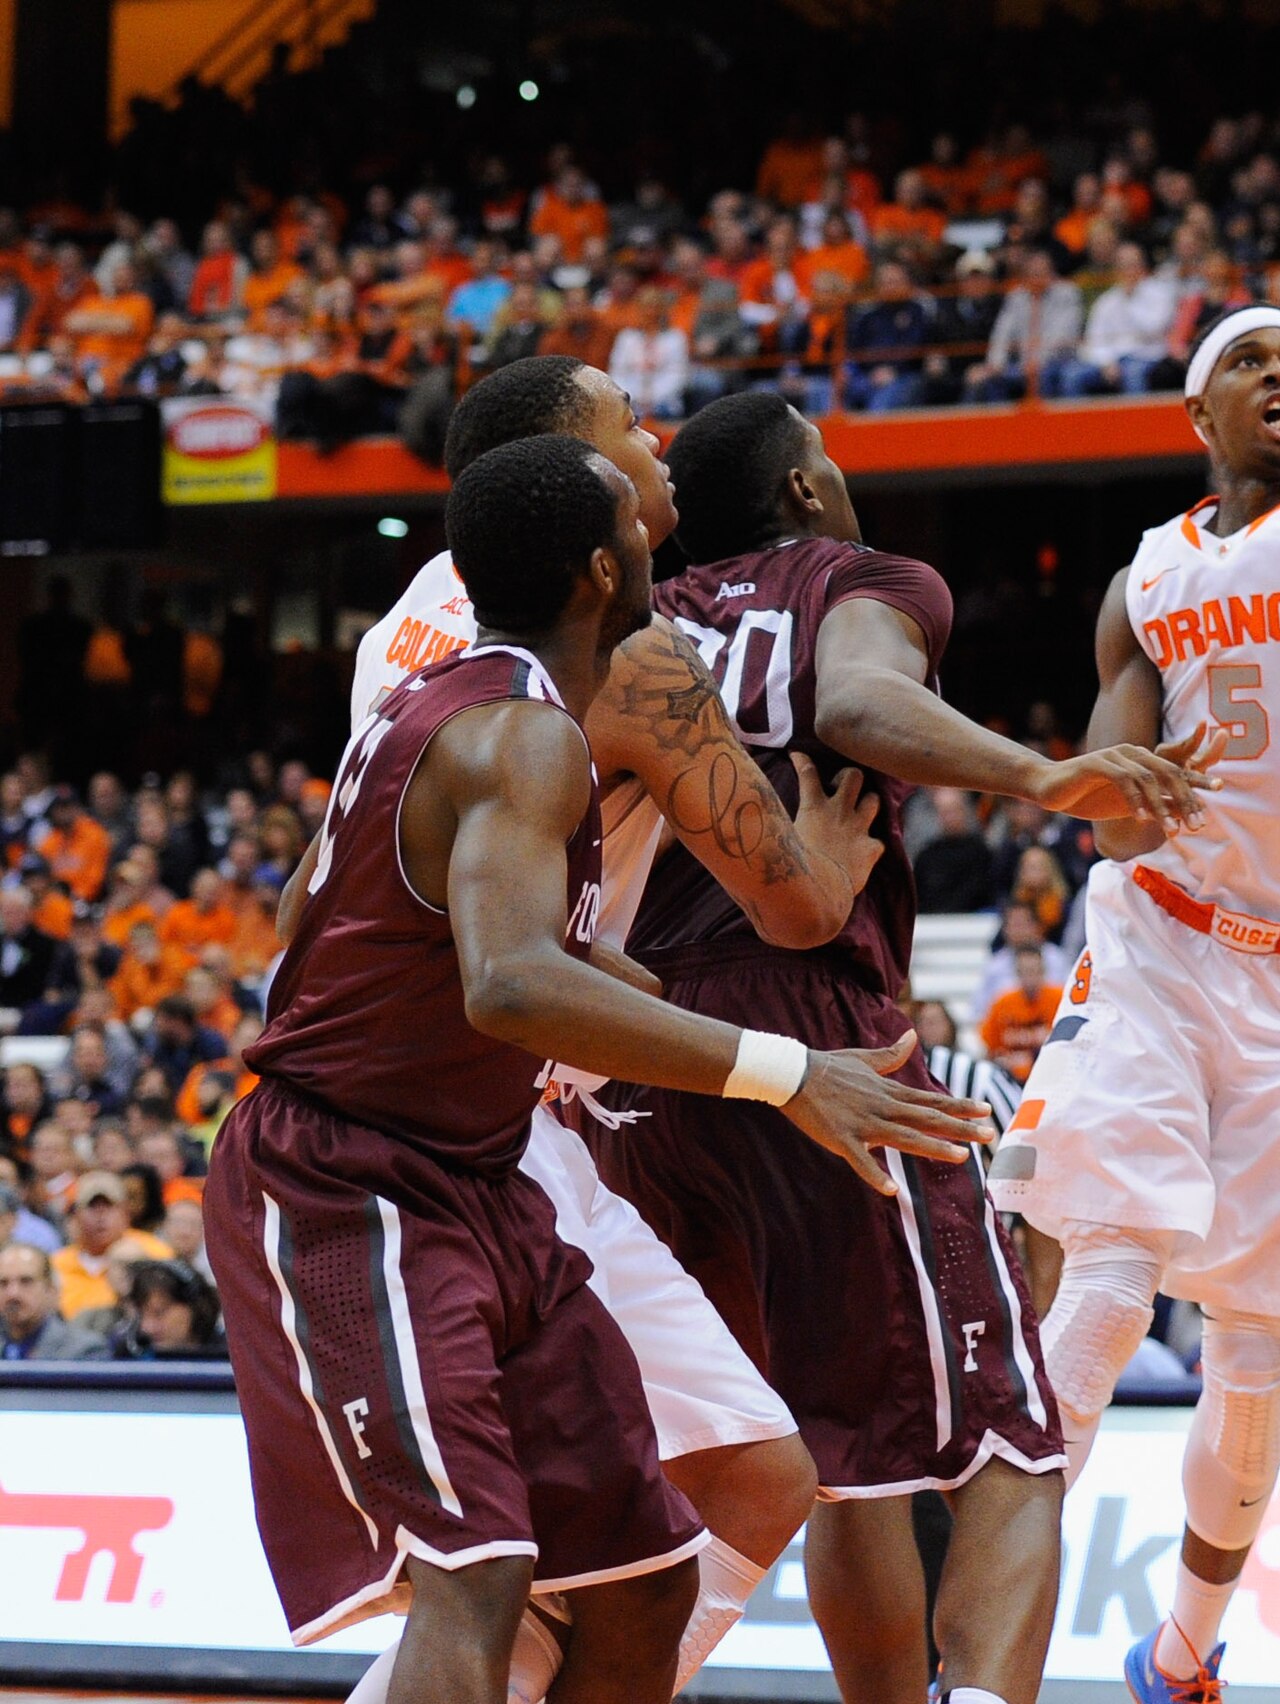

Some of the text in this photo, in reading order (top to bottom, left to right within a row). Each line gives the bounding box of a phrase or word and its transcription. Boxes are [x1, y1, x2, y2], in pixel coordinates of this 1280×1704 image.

[1206, 663, 1270, 761] 5
[961, 1319, 986, 1374] F
[341, 1396, 373, 1461] F
